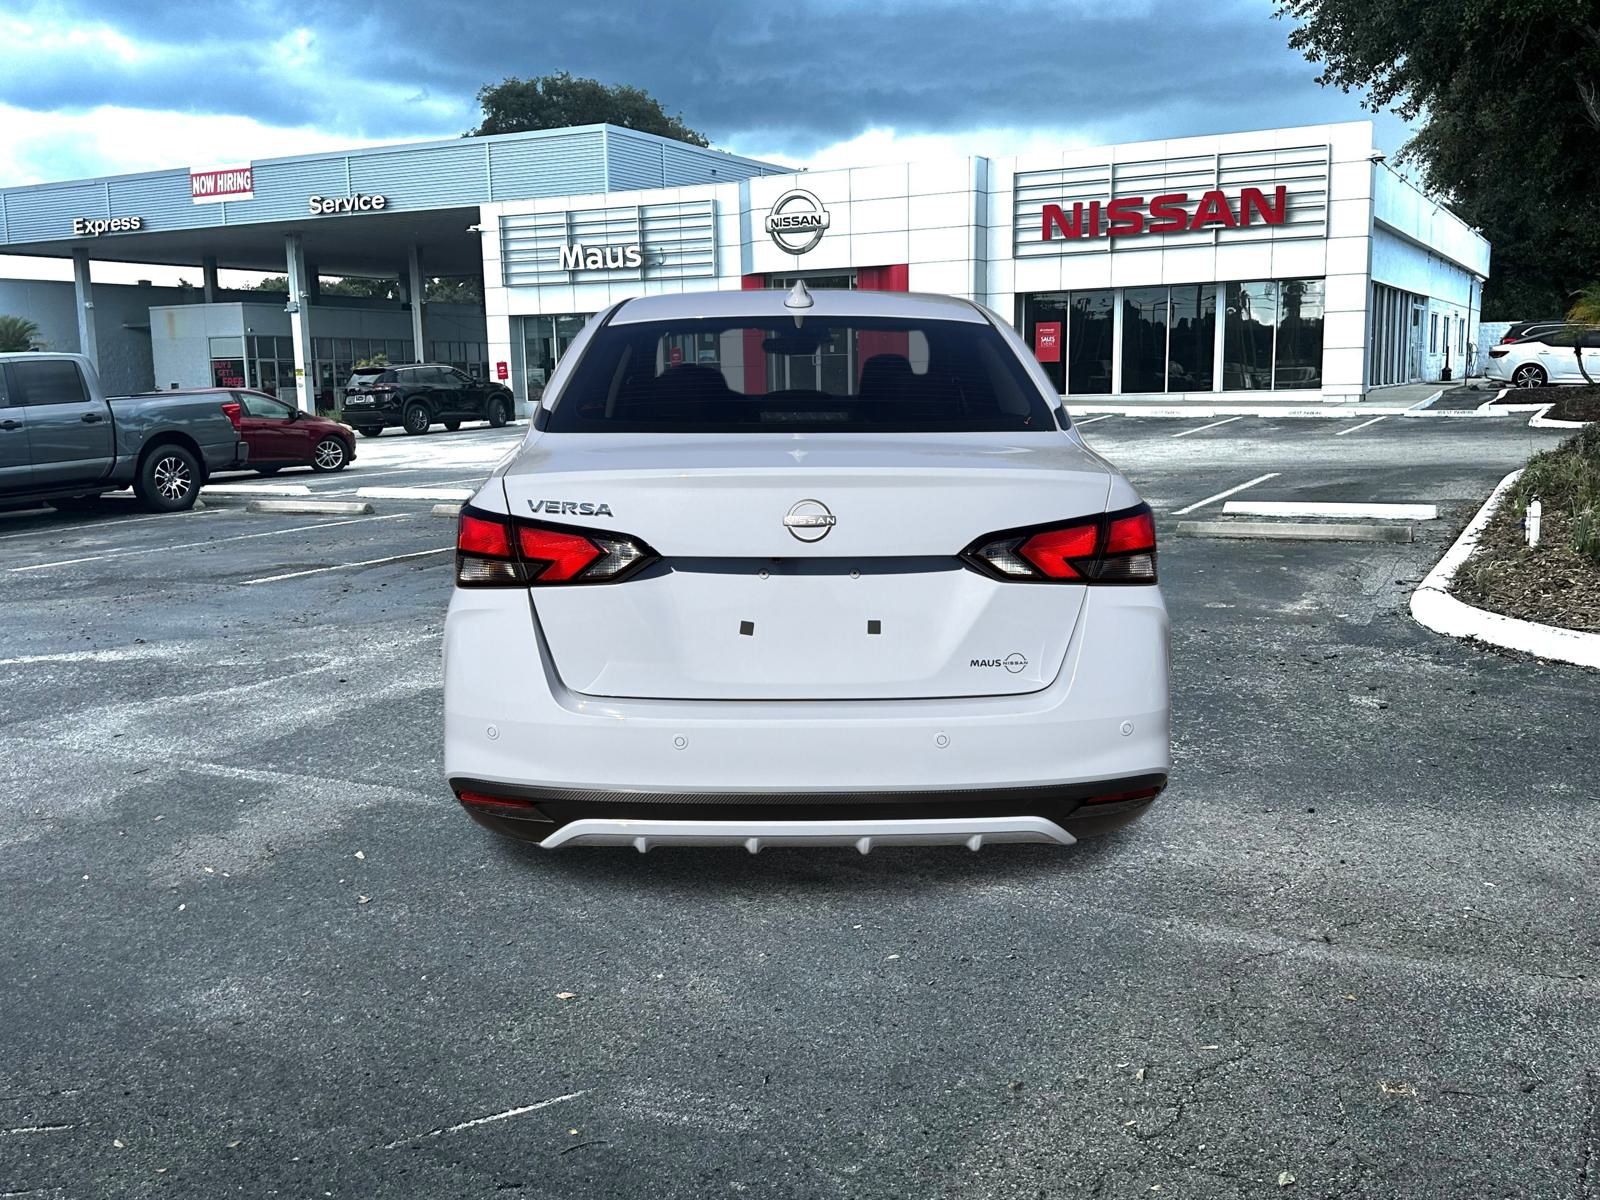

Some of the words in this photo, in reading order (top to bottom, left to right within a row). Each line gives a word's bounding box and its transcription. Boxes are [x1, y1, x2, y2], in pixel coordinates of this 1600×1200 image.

[192, 174, 216, 195] NOW
[216, 171, 251, 193] HIRING
[309, 193, 385, 215] Service
[1042, 185, 1287, 241] NISSAN
[73, 216, 141, 237] Express
[770, 214, 822, 228] NISSAN
[559, 243, 642, 270] Maus
[223, 377, 244, 386] FREE
[527, 499, 614, 518] VERSA
[784, 515, 836, 526] NISSAN
[970, 659, 1002, 667] MAUS
